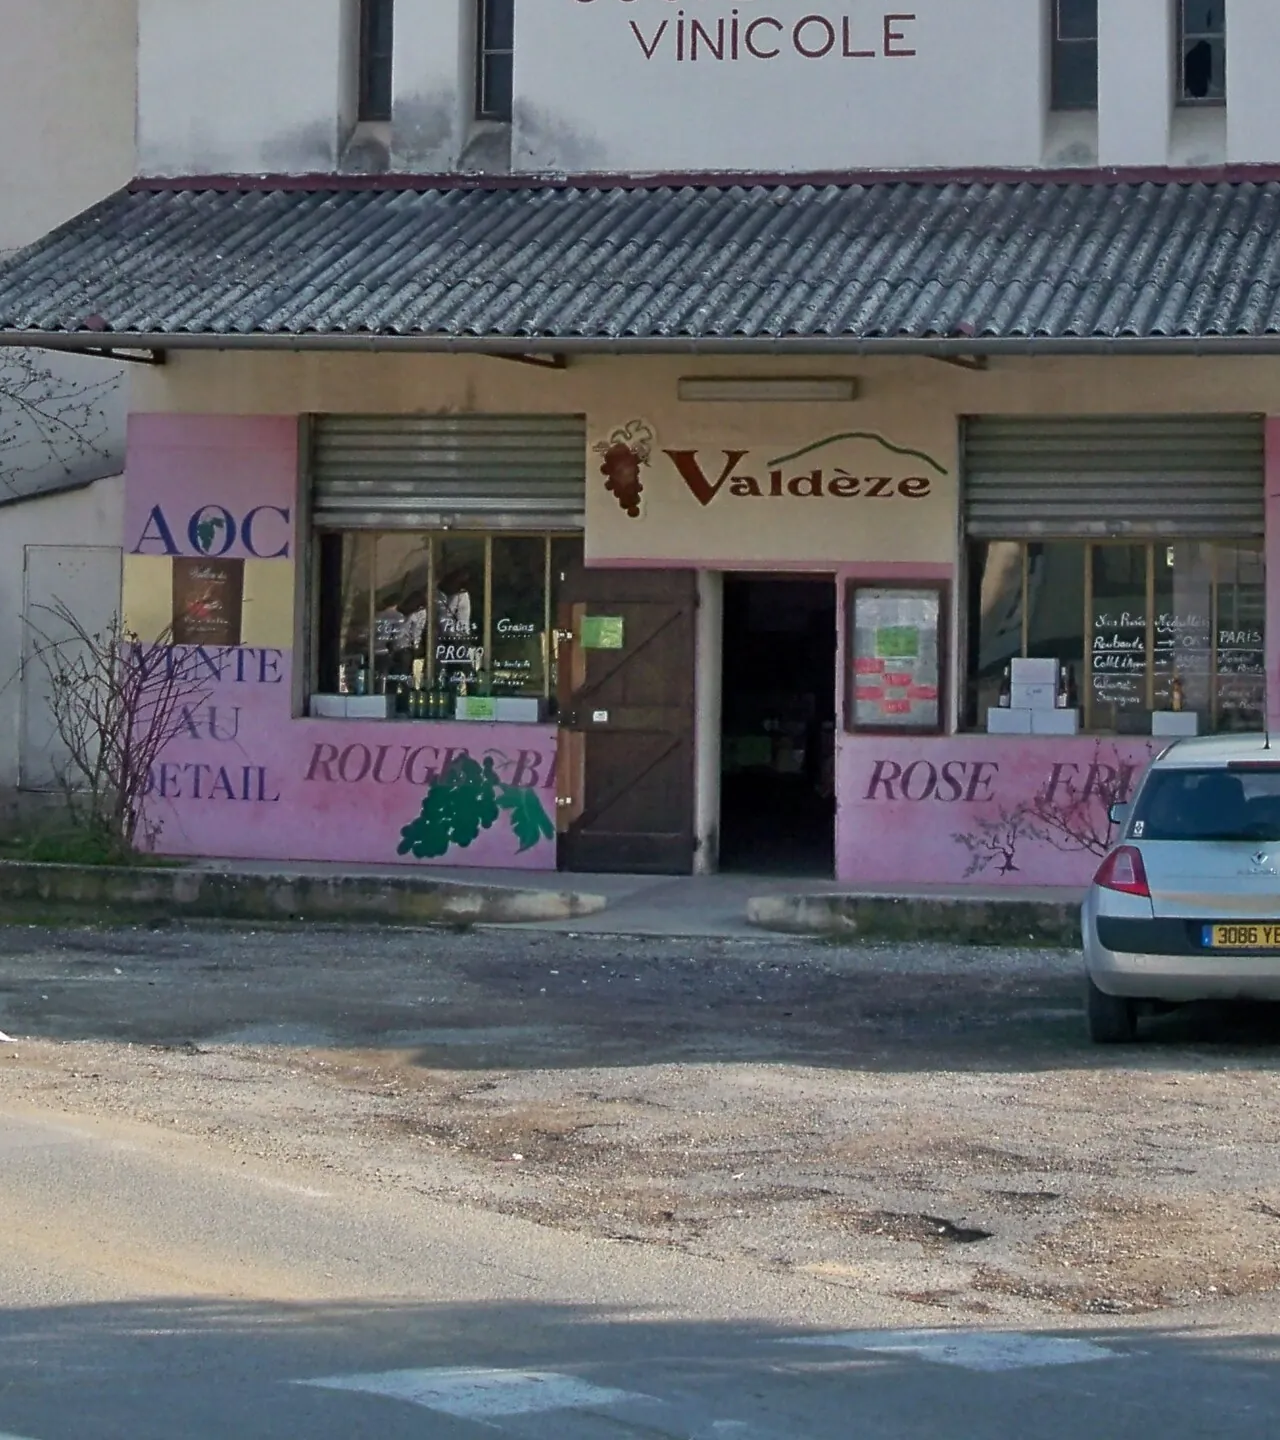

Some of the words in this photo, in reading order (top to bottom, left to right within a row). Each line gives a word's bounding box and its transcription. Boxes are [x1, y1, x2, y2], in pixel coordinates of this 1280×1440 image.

[628, 9, 917, 62] VINICOLE
[662, 449, 932, 506] Valdèze
[129, 503, 291, 559] AOC
[497, 618, 534, 632] Grains
[1219, 629, 1262, 644] PARIS
[130, 642, 283, 683] VENTE
[170, 705, 242, 742] AU
[304, 742, 470, 788] ROUGE
[862, 759, 1000, 803] ROSE
[1218, 927, 1258, 944] 3086
